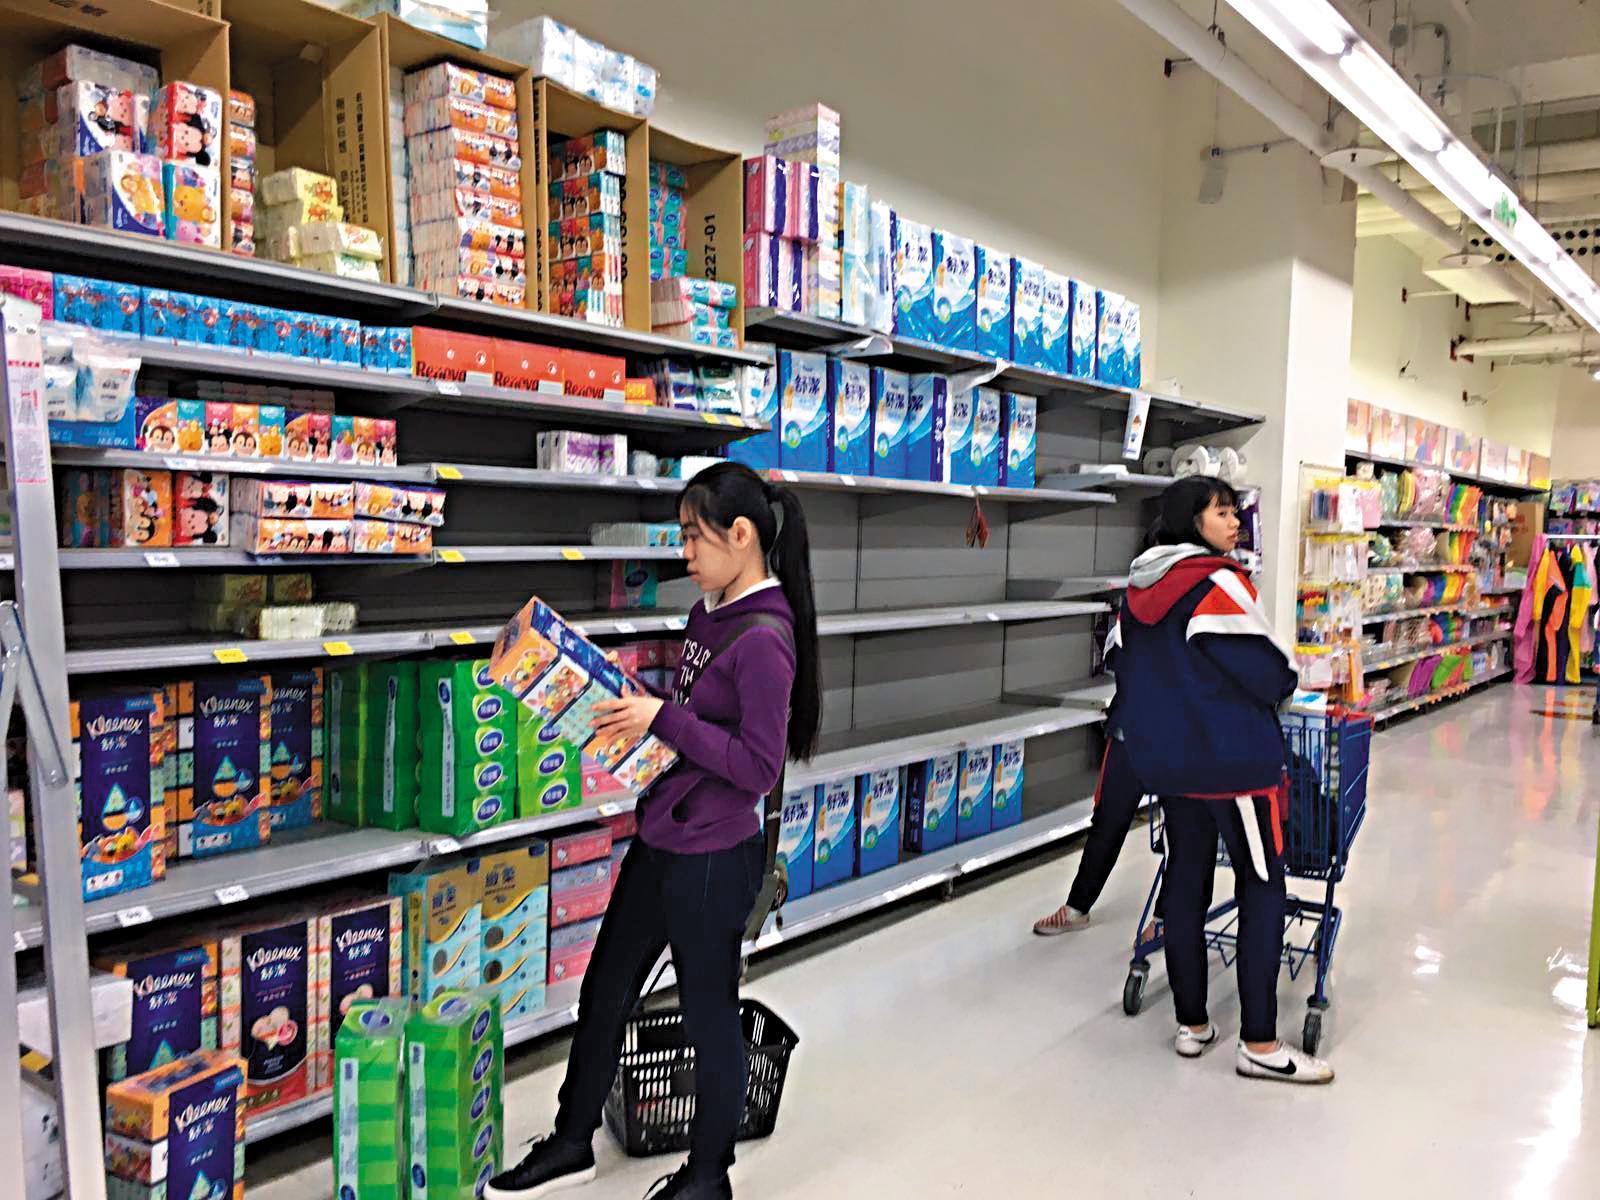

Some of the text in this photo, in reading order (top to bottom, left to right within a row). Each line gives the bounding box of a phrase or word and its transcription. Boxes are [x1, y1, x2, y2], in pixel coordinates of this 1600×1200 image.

[704, 213, 717, 281] 227-01
[415, 361, 467, 382] Renova
[494, 371, 540, 392] Renova
[563, 380, 605, 399] Renova
[200, 695, 254, 719] Kleenex
[272, 687, 307, 702] eenex
[86, 714, 143, 740] Kleenex
[335, 927, 386, 953] Kleenex
[246, 945, 303, 973] Kleenex
[133, 971, 196, 1001] Kleenex
[175, 1095, 232, 1135] Kleenex
